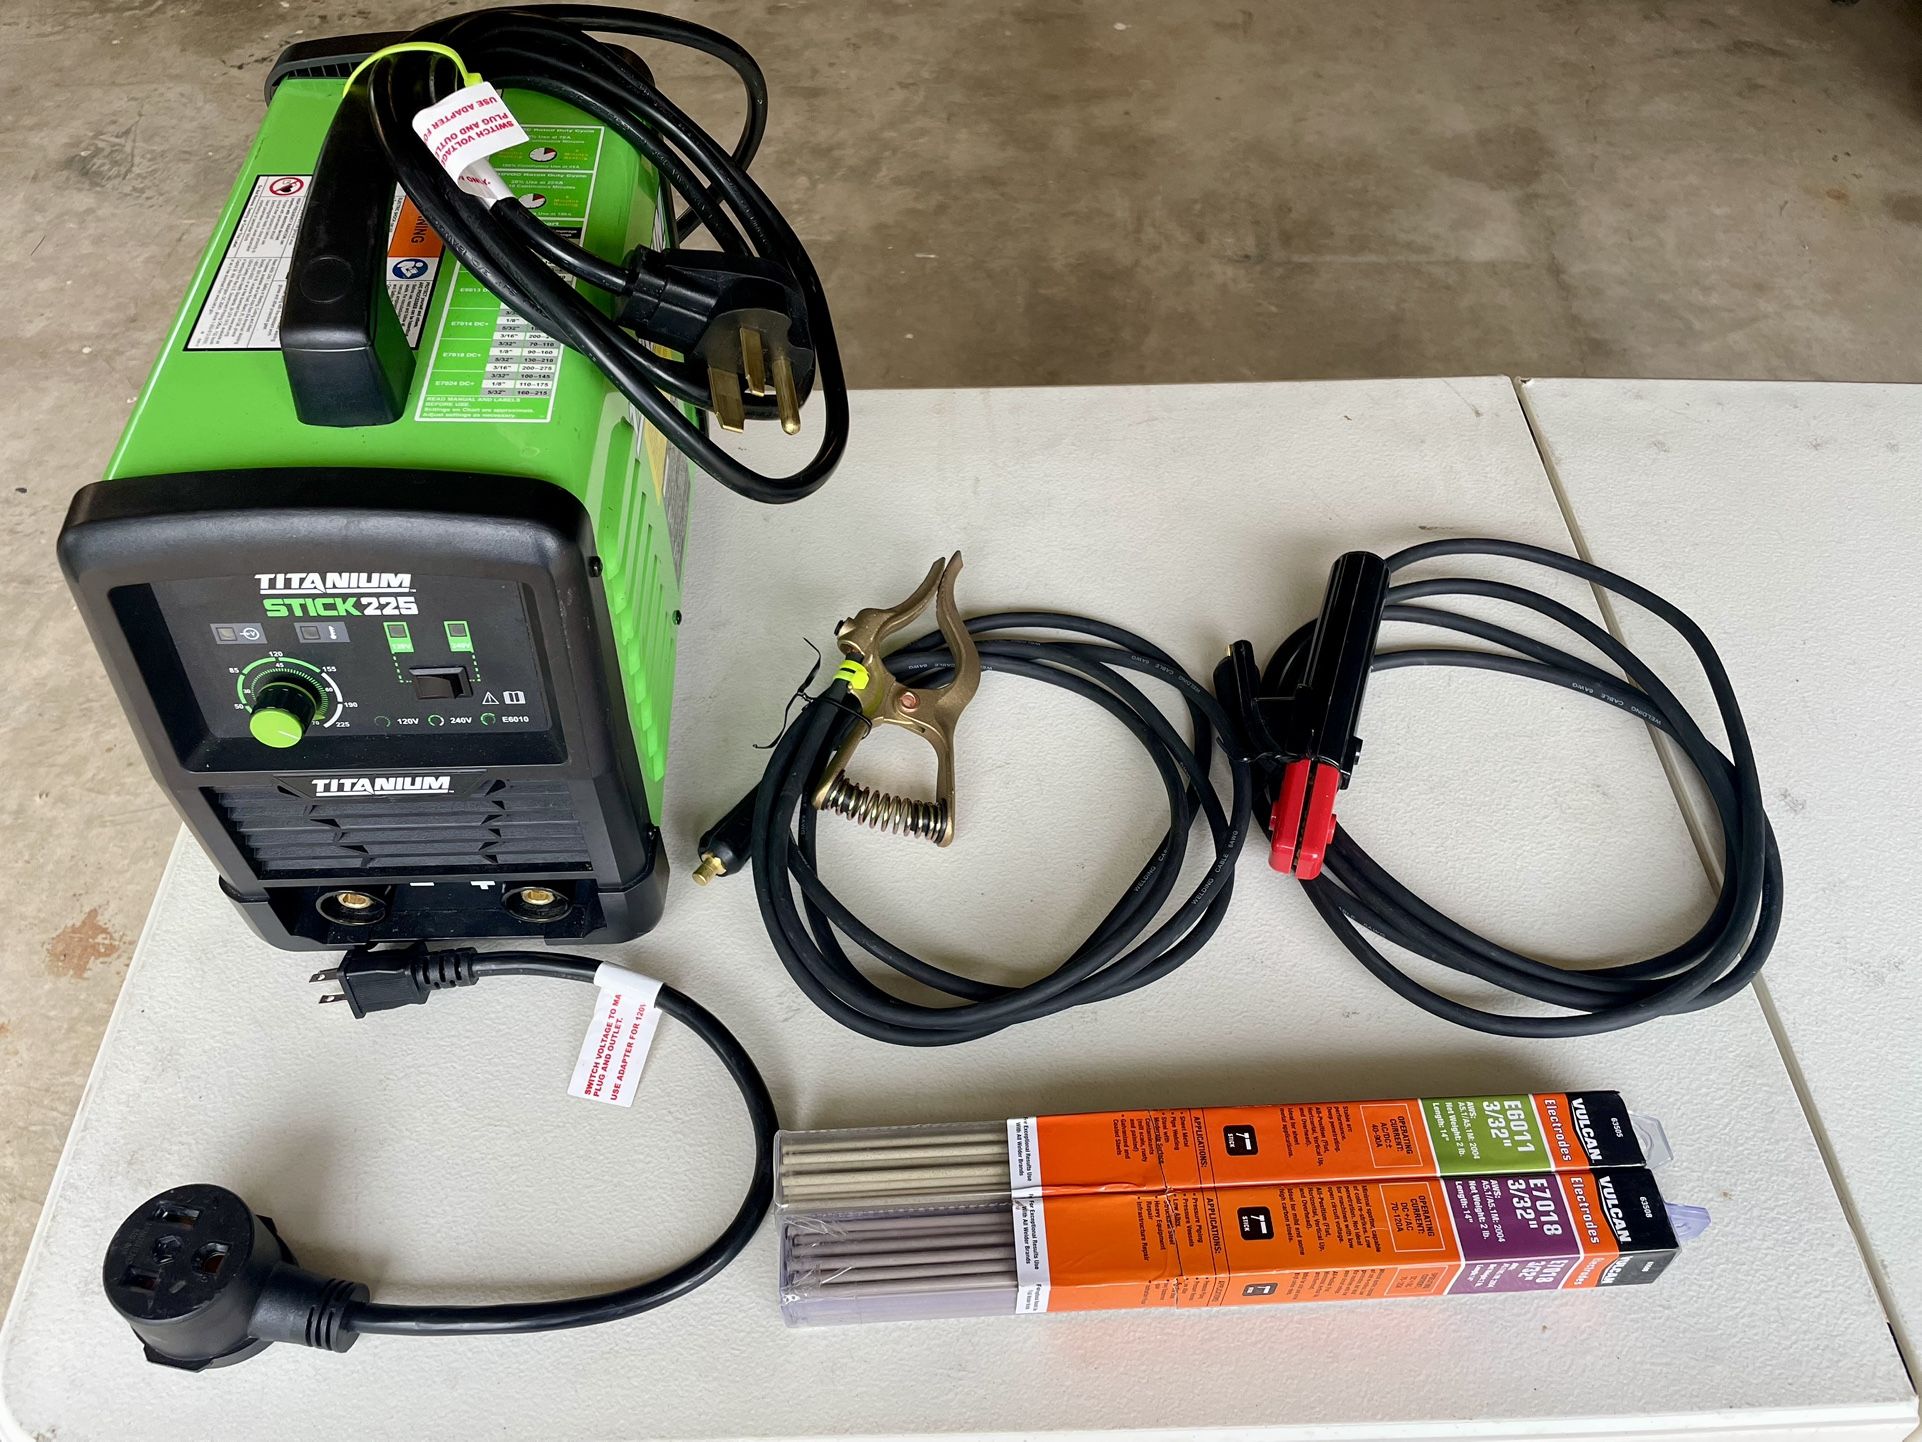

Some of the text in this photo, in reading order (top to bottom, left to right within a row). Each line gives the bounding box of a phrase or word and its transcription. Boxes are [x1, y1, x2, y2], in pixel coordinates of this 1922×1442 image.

[431, 96, 498, 130] USE ADAPTER
[459, 122, 480, 136] AND
[475, 120, 514, 139] SWITCH
[482, 112, 509, 126] PLUG
[254, 572, 412, 589] TITANIUM
[450, 716, 472, 724] 240V
[1600, 692, 1624, 706] CABLE
[1630, 705, 1662, 726] WELDING
[311, 776, 451, 792] TITANIUM
[1134, 865, 1156, 892] WELDING
[1190, 877, 1214, 906] WELDING
[1214, 853, 1229, 873] CABLE
[584, 1061, 600, 1096] SWITCH
[596, 1022, 614, 1060] VOLTAGE
[608, 1008, 617, 1020] TO
[593, 1017, 624, 1098] PLUG AND OUTLET.
[610, 1082, 622, 1102] USE
[616, 1042, 634, 1082] ADAPTER
[629, 1022, 640, 1041] FOR
[1432, 1102, 1445, 1128] Length:
[1466, 1102, 1477, 1119] AWS:
[1482, 1100, 1512, 1147] 3/32"
[1504, 1100, 1535, 1152] E6011
[1610, 1117, 1624, 1138] 63505
[1172, 1129, 1180, 1151] Welding
[1182, 1132, 1190, 1148] Metal
[1193, 1116, 1208, 1168] APPLICATIONS:
[1228, 1133, 1236, 1148] STICK
[1390, 1118, 1404, 1152] CURRENT:
[1397, 1116, 1414, 1154] OPERATING
[1444, 1102, 1454, 1114] Net
[1449, 1114, 1462, 1141] Weight:
[1458, 1148, 1466, 1157] lb.
[1544, 1098, 1572, 1162] Electrodes
[1572, 1098, 1603, 1161] VULCAN
[1469, 1142, 1480, 1159] 2004
[1456, 1181, 1474, 1222] Length: 14"
[1468, 1180, 1478, 1194] Net
[1490, 1180, 1502, 1198] AWS:
[1192, 1198, 1204, 1244] Pressure Piping
[1390, 1202, 1404, 1232] 70-120A
[1410, 1198, 1425, 1234] CURRENT:
[1418, 1195, 1435, 1237] OPERATING
[1472, 1194, 1486, 1222] Weight:
[1508, 1180, 1538, 1229] 3/32"
[1528, 1178, 1563, 1236] E7018
[1570, 1177, 1600, 1244] Electrodes
[1598, 1176, 1632, 1242] VULCAN
[1640, 1196, 1653, 1218] 63508
[1030, 1209, 1038, 1239] Exceptional
[1136, 1201, 1150, 1262] Infrastructure Repair
[1154, 1200, 1166, 1250] Heavy Equipment
[1168, 1228, 1176, 1246] Steel
[1182, 1198, 1194, 1247] Pressure Vessels
[1206, 1197, 1222, 1254] APPLICATIONS:
[1242, 1216, 1250, 1232] STICK
[1482, 1230, 1490, 1240] lb.
[1494, 1224, 1506, 1242] 2004
[1536, 1260, 1569, 1283] E7018
